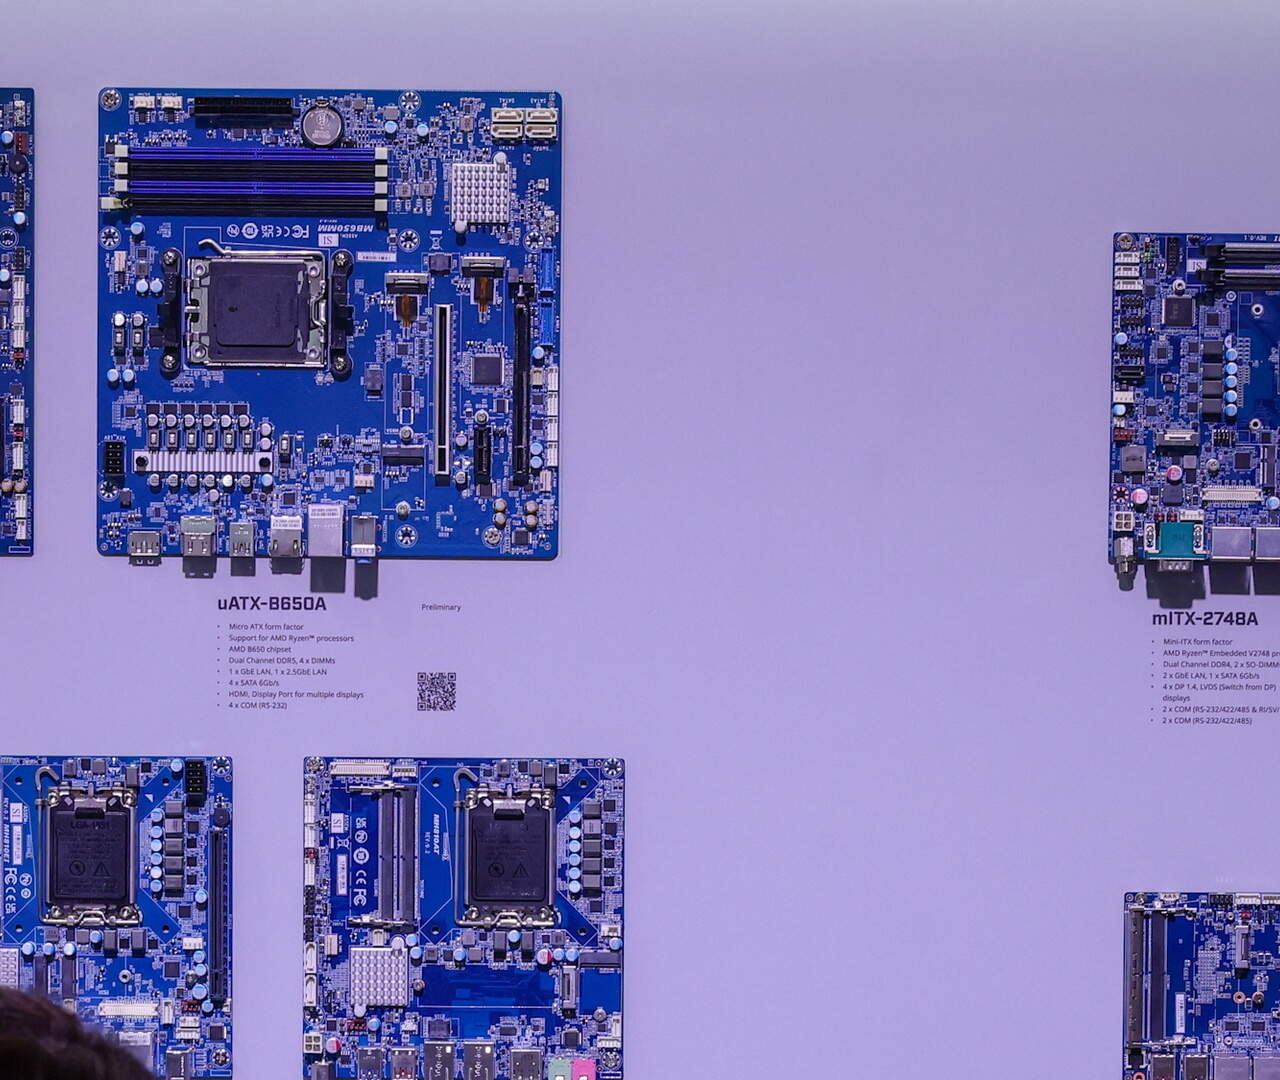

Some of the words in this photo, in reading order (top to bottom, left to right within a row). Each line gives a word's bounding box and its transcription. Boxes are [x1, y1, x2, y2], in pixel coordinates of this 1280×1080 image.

[218, 597, 326, 610] uATX-B650A
[421, 604, 461, 612] Preliminary
[1153, 612, 1258, 625] mITX-2748A
[229, 622, 249, 630] Micro
[250, 623, 263, 631] ATX
[265, 622, 282, 630] form
[283, 622, 304, 630] factor
[228, 635, 257, 643] Support
[258, 633, 269, 641] for
[270, 634, 287, 642] AMD
[316, 635, 354, 643] processors
[1163, 637, 1192, 645] Mini-ITX
[1193, 637, 1211, 645] form
[1212, 637, 1233, 645] factor
[229, 645, 246, 653] AMD
[266, 646, 291, 654] chipset
[1163, 649, 1181, 657] AMD
[1209, 649, 1247, 657] Embedded
[251, 691, 277, 699] Display
[278, 690, 293, 698] Port
[294, 690, 305, 698] for
[306, 691, 335, 699] multiple
[336, 691, 364, 699] displays
[1162, 694, 1190, 703] displays
